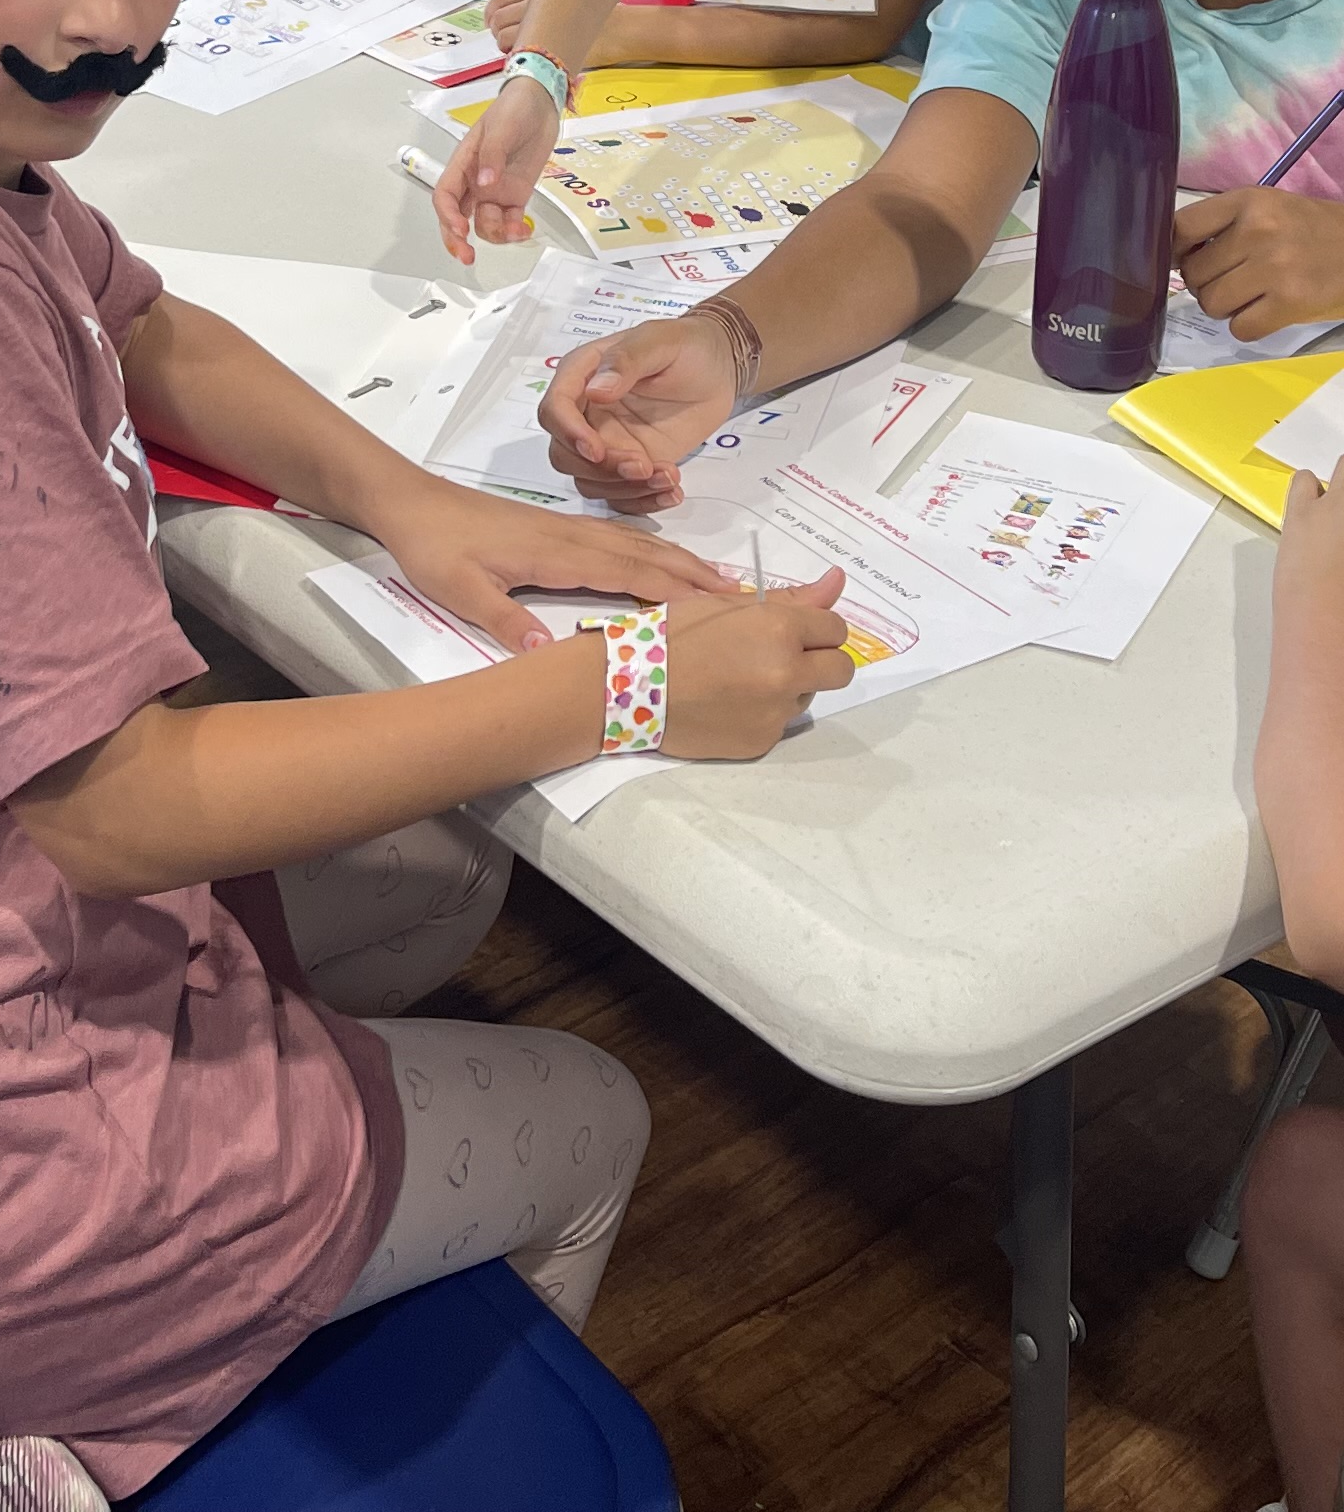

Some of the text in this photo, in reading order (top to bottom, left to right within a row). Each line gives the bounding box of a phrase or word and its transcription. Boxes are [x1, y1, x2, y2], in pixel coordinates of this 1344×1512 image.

[214, 14, 236, 26] 6
[195, 37, 232, 55] 10
[758, 410, 783, 424] 7
[786, 463, 910, 542] Rainbow Colours in French
[774, 507, 922, 601] Can you colour the rainbow?
